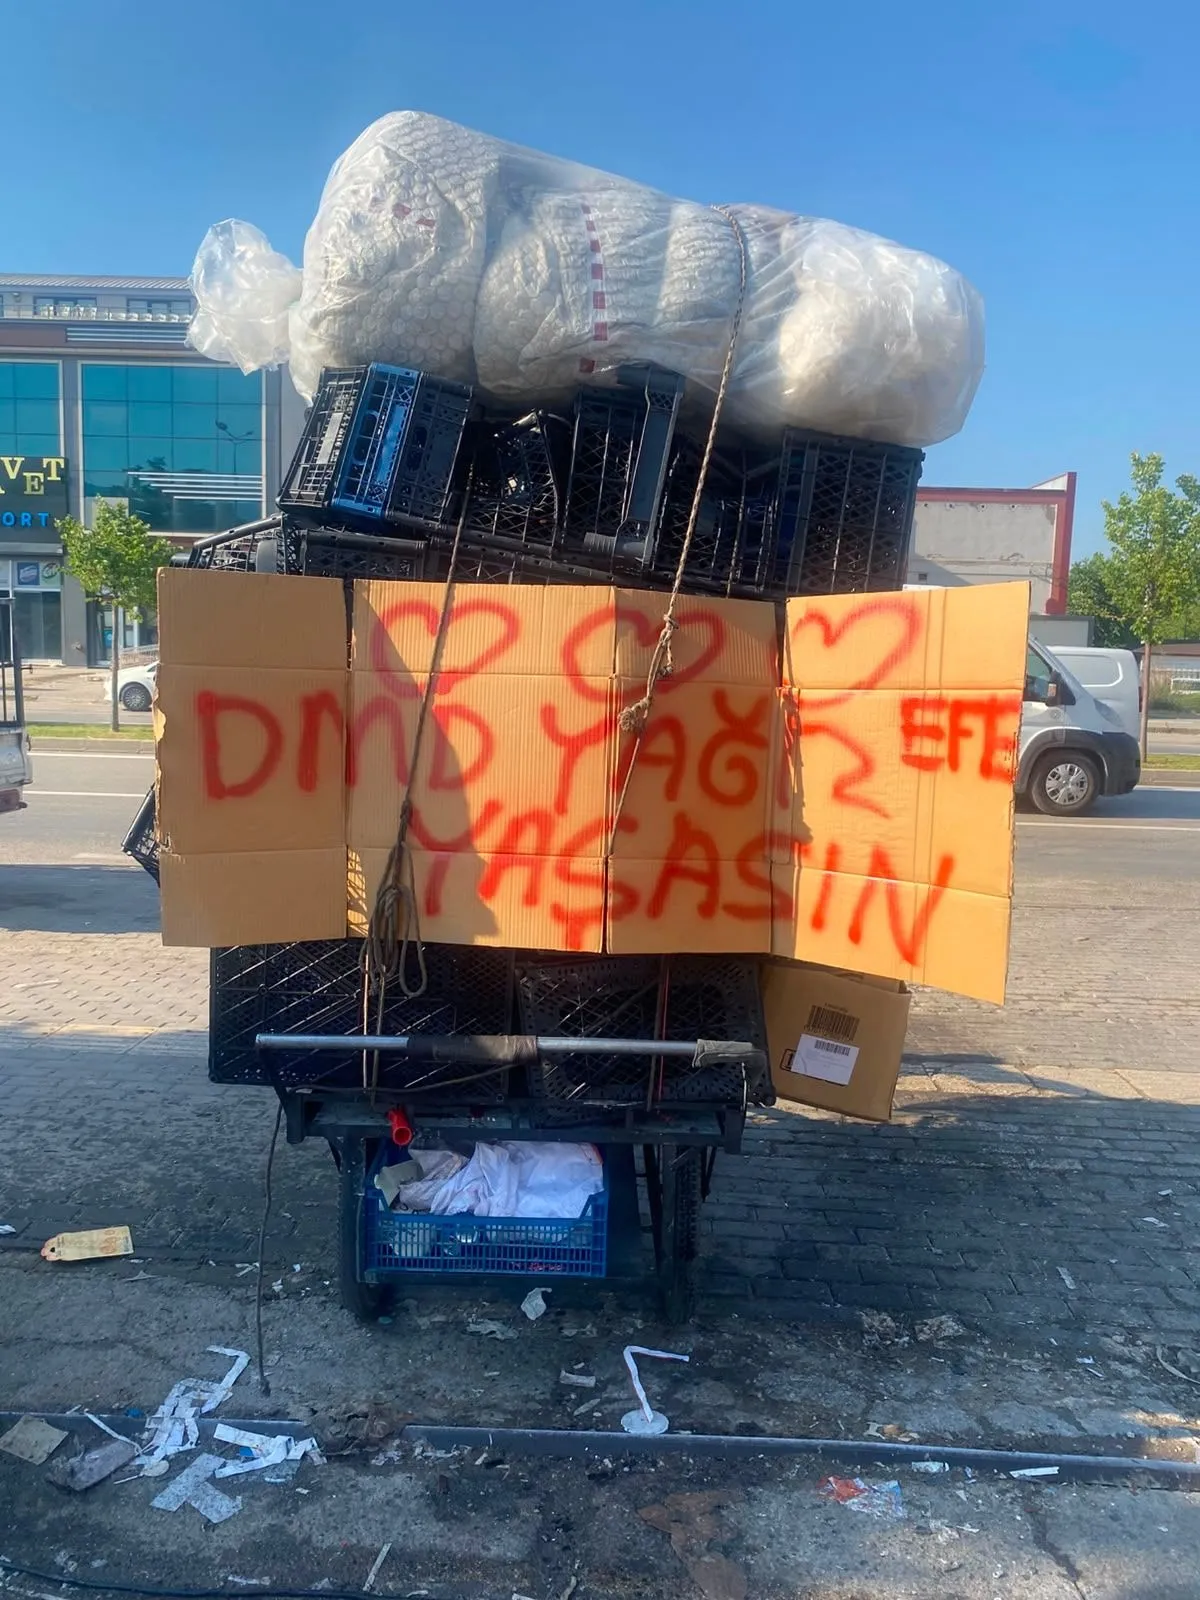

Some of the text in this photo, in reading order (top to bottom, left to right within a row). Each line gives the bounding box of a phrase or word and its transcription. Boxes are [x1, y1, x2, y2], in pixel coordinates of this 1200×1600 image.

[0, 457, 65, 494] VET
[195, 690, 495, 799] DMD
[900, 696, 1021, 784] EFE
[407, 799, 955, 966] YAŞASIN
